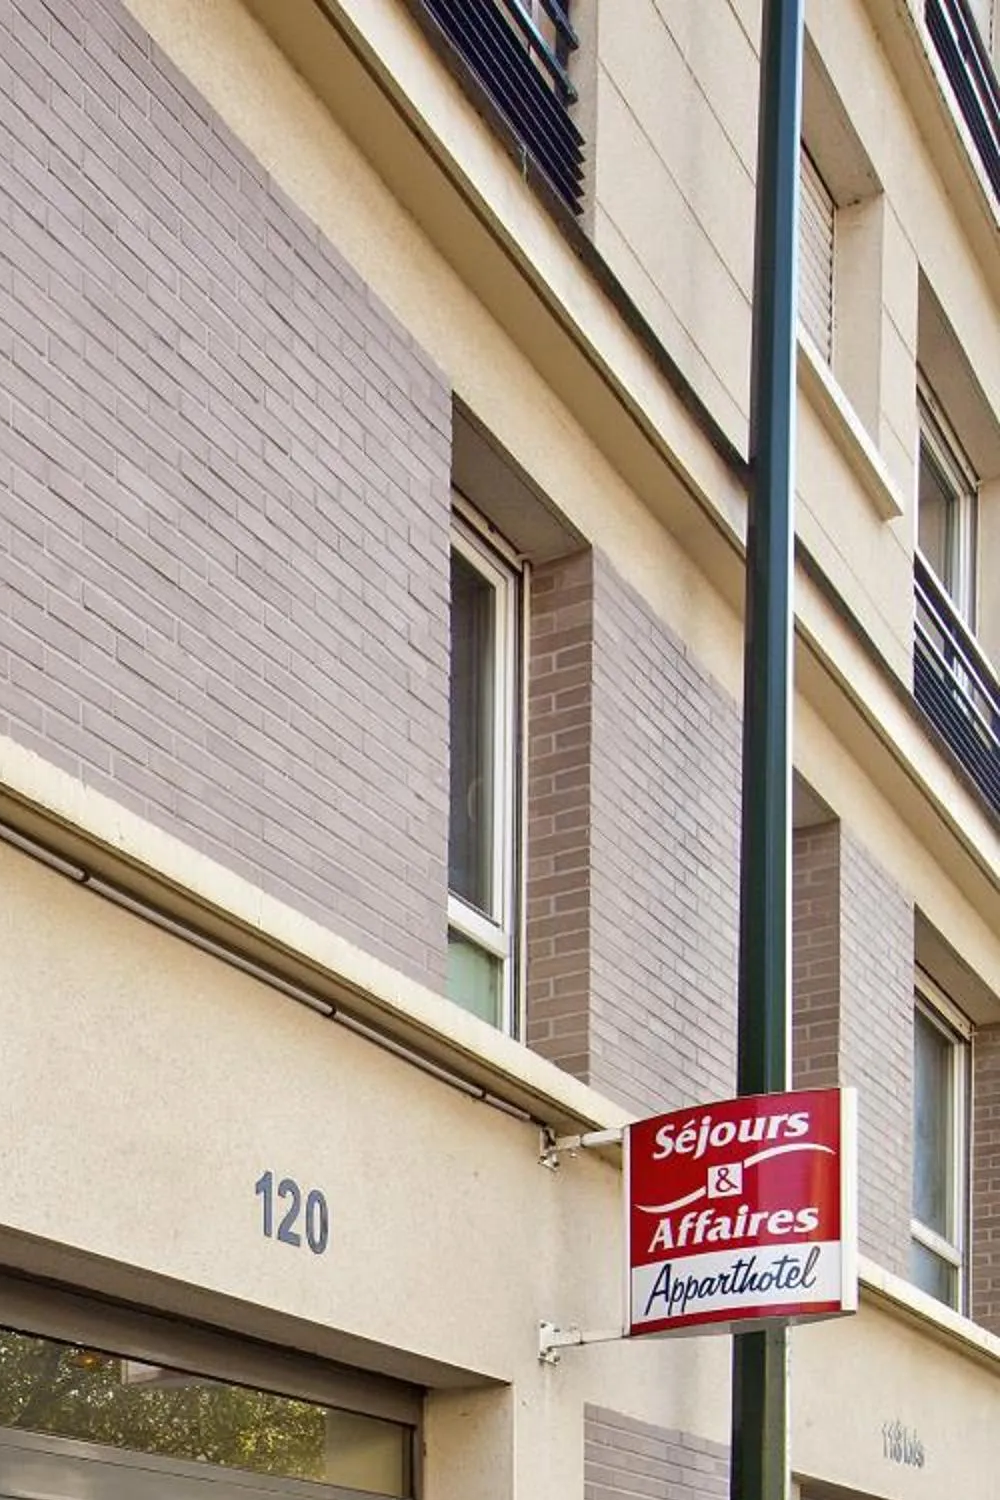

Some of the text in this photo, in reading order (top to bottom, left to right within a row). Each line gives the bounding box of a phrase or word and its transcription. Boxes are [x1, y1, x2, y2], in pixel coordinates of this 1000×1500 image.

[652, 1110, 810, 1160] Séjours
[715, 1166, 739, 1193] &
[255, 1170, 329, 1255] 120
[648, 1203, 819, 1253] Affaires
[644, 1245, 821, 1316] Apparthotel
